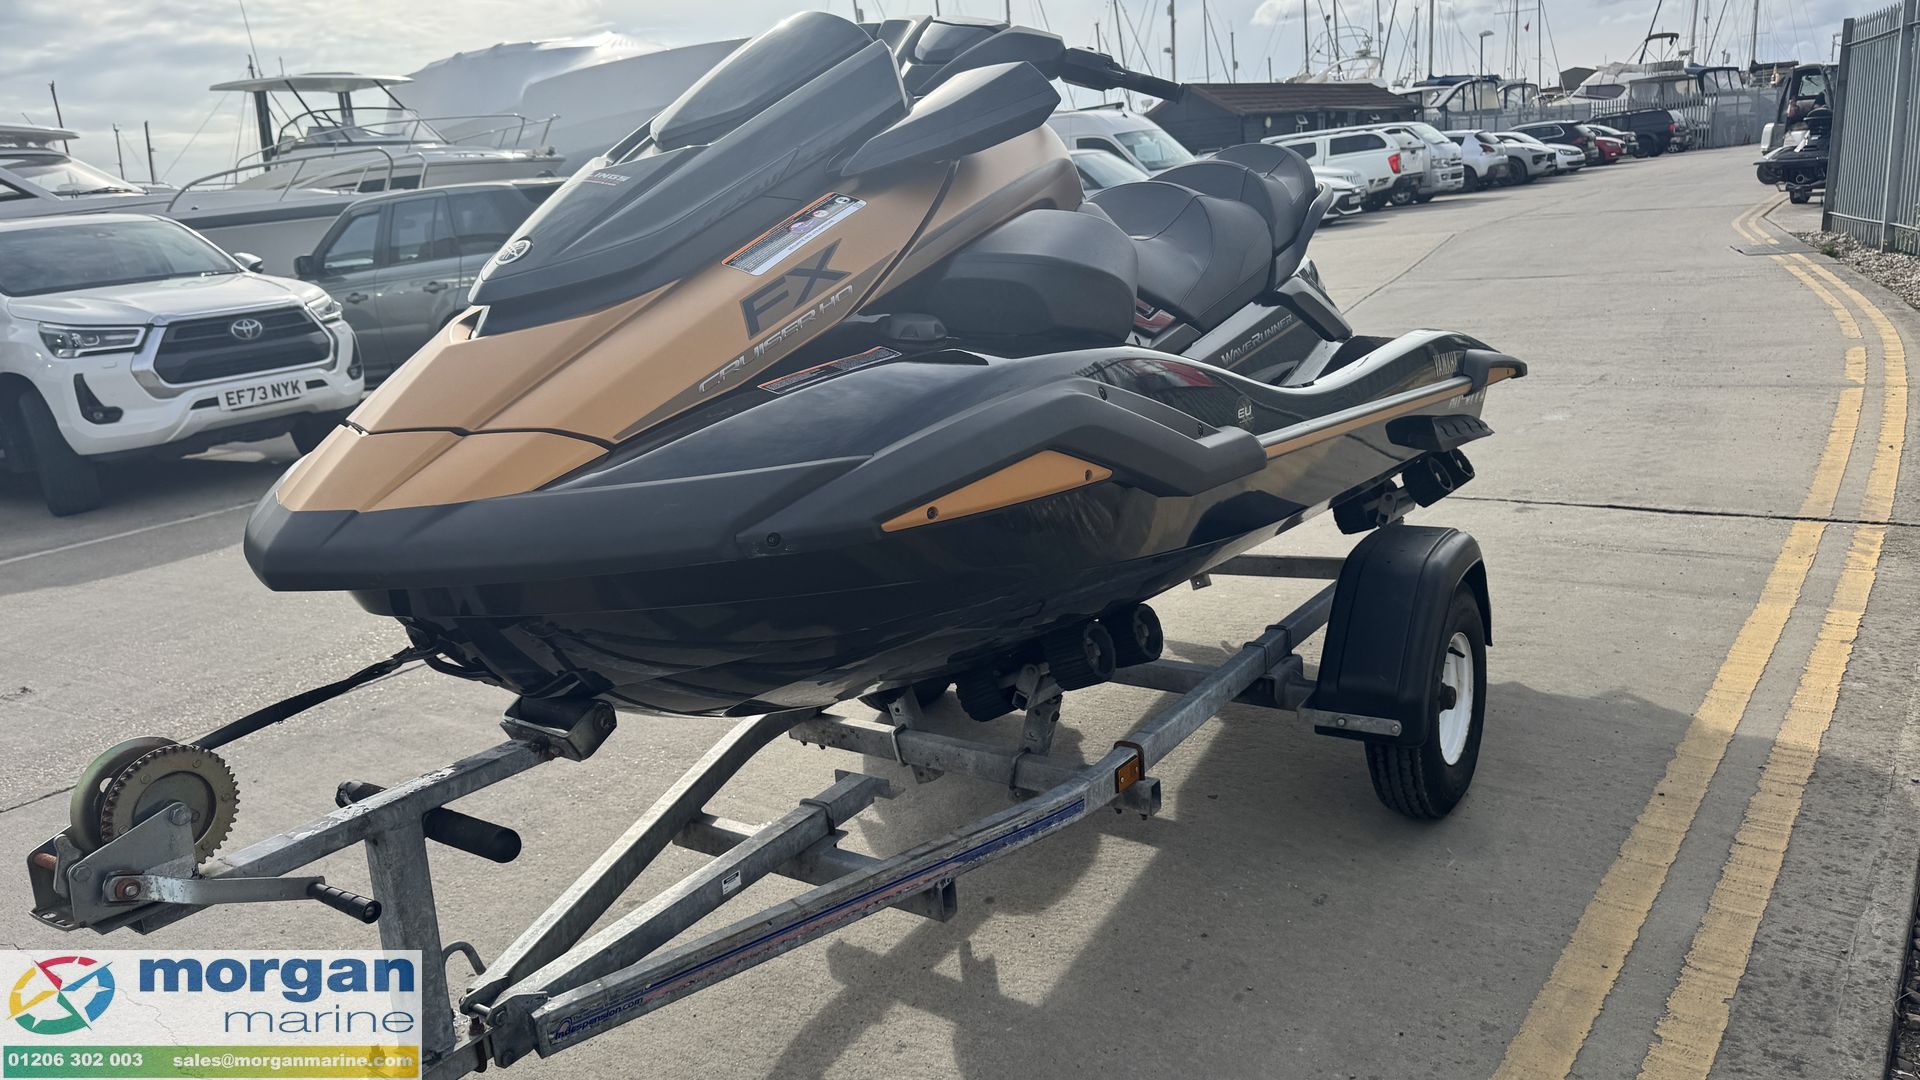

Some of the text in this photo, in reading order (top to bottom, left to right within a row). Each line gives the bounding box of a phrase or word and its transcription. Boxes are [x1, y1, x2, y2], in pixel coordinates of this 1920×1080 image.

[739, 238, 852, 340] FX
[699, 309, 816, 393] CRUISER
[1433, 351, 1458, 377] YAMAHA
[225, 380, 302, 406] EF73 NYK
[1237, 404, 1252, 419] EU
